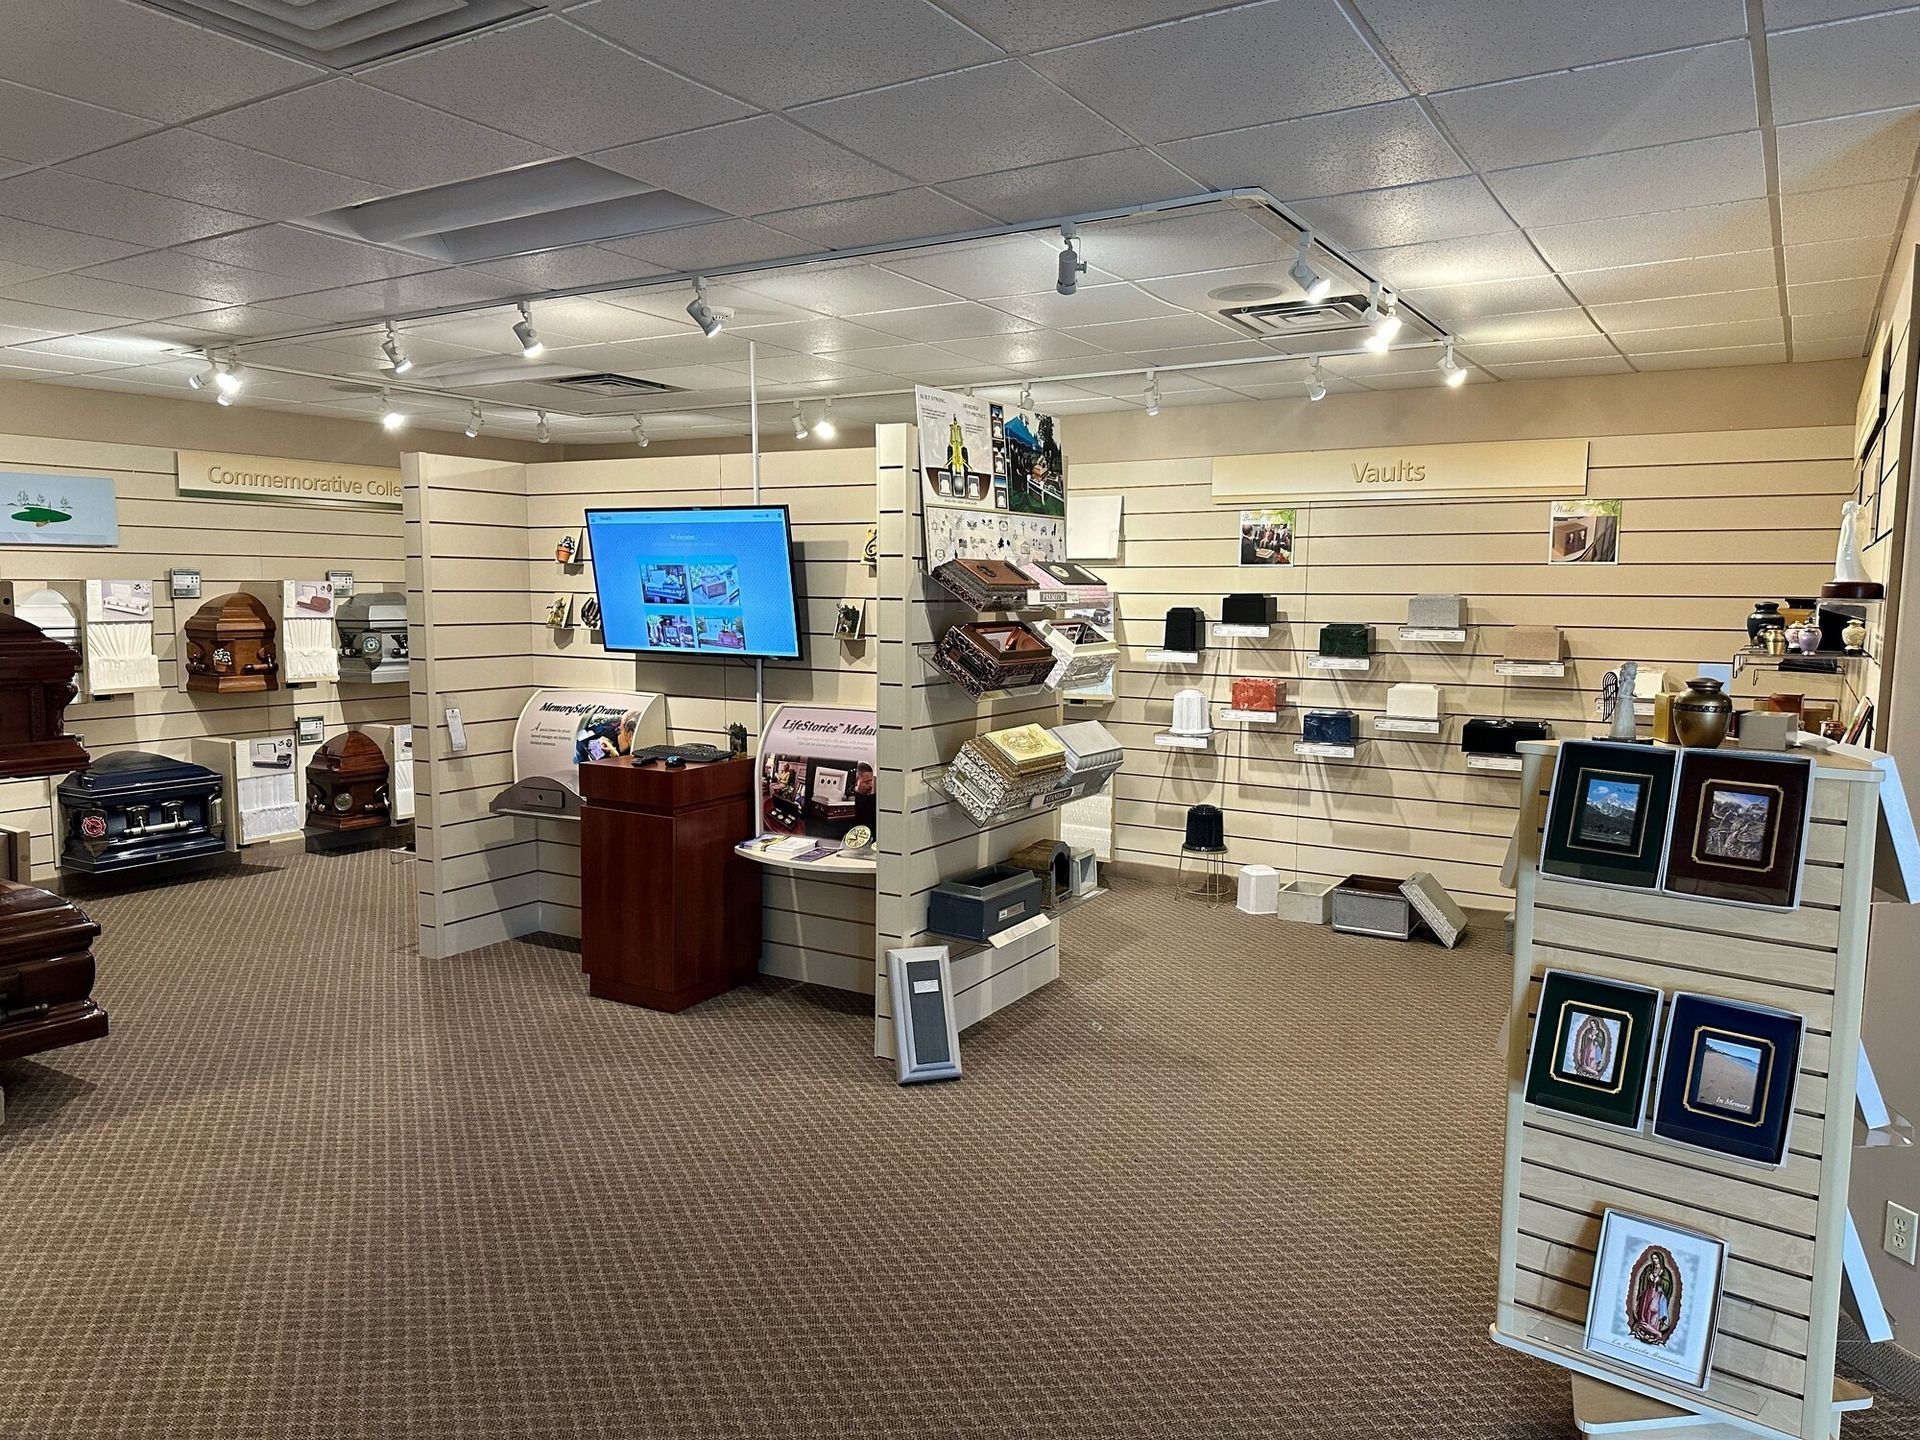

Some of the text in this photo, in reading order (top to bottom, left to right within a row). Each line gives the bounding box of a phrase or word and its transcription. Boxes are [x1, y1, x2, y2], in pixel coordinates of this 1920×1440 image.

[1351, 459, 1426, 483] Vaults
[207, 465, 402, 497] Commemorative Colle
[1042, 592, 1066, 602] PREMIUM
[594, 704, 628, 716] Drawer
[1716, 1096, 1724, 1104] In
